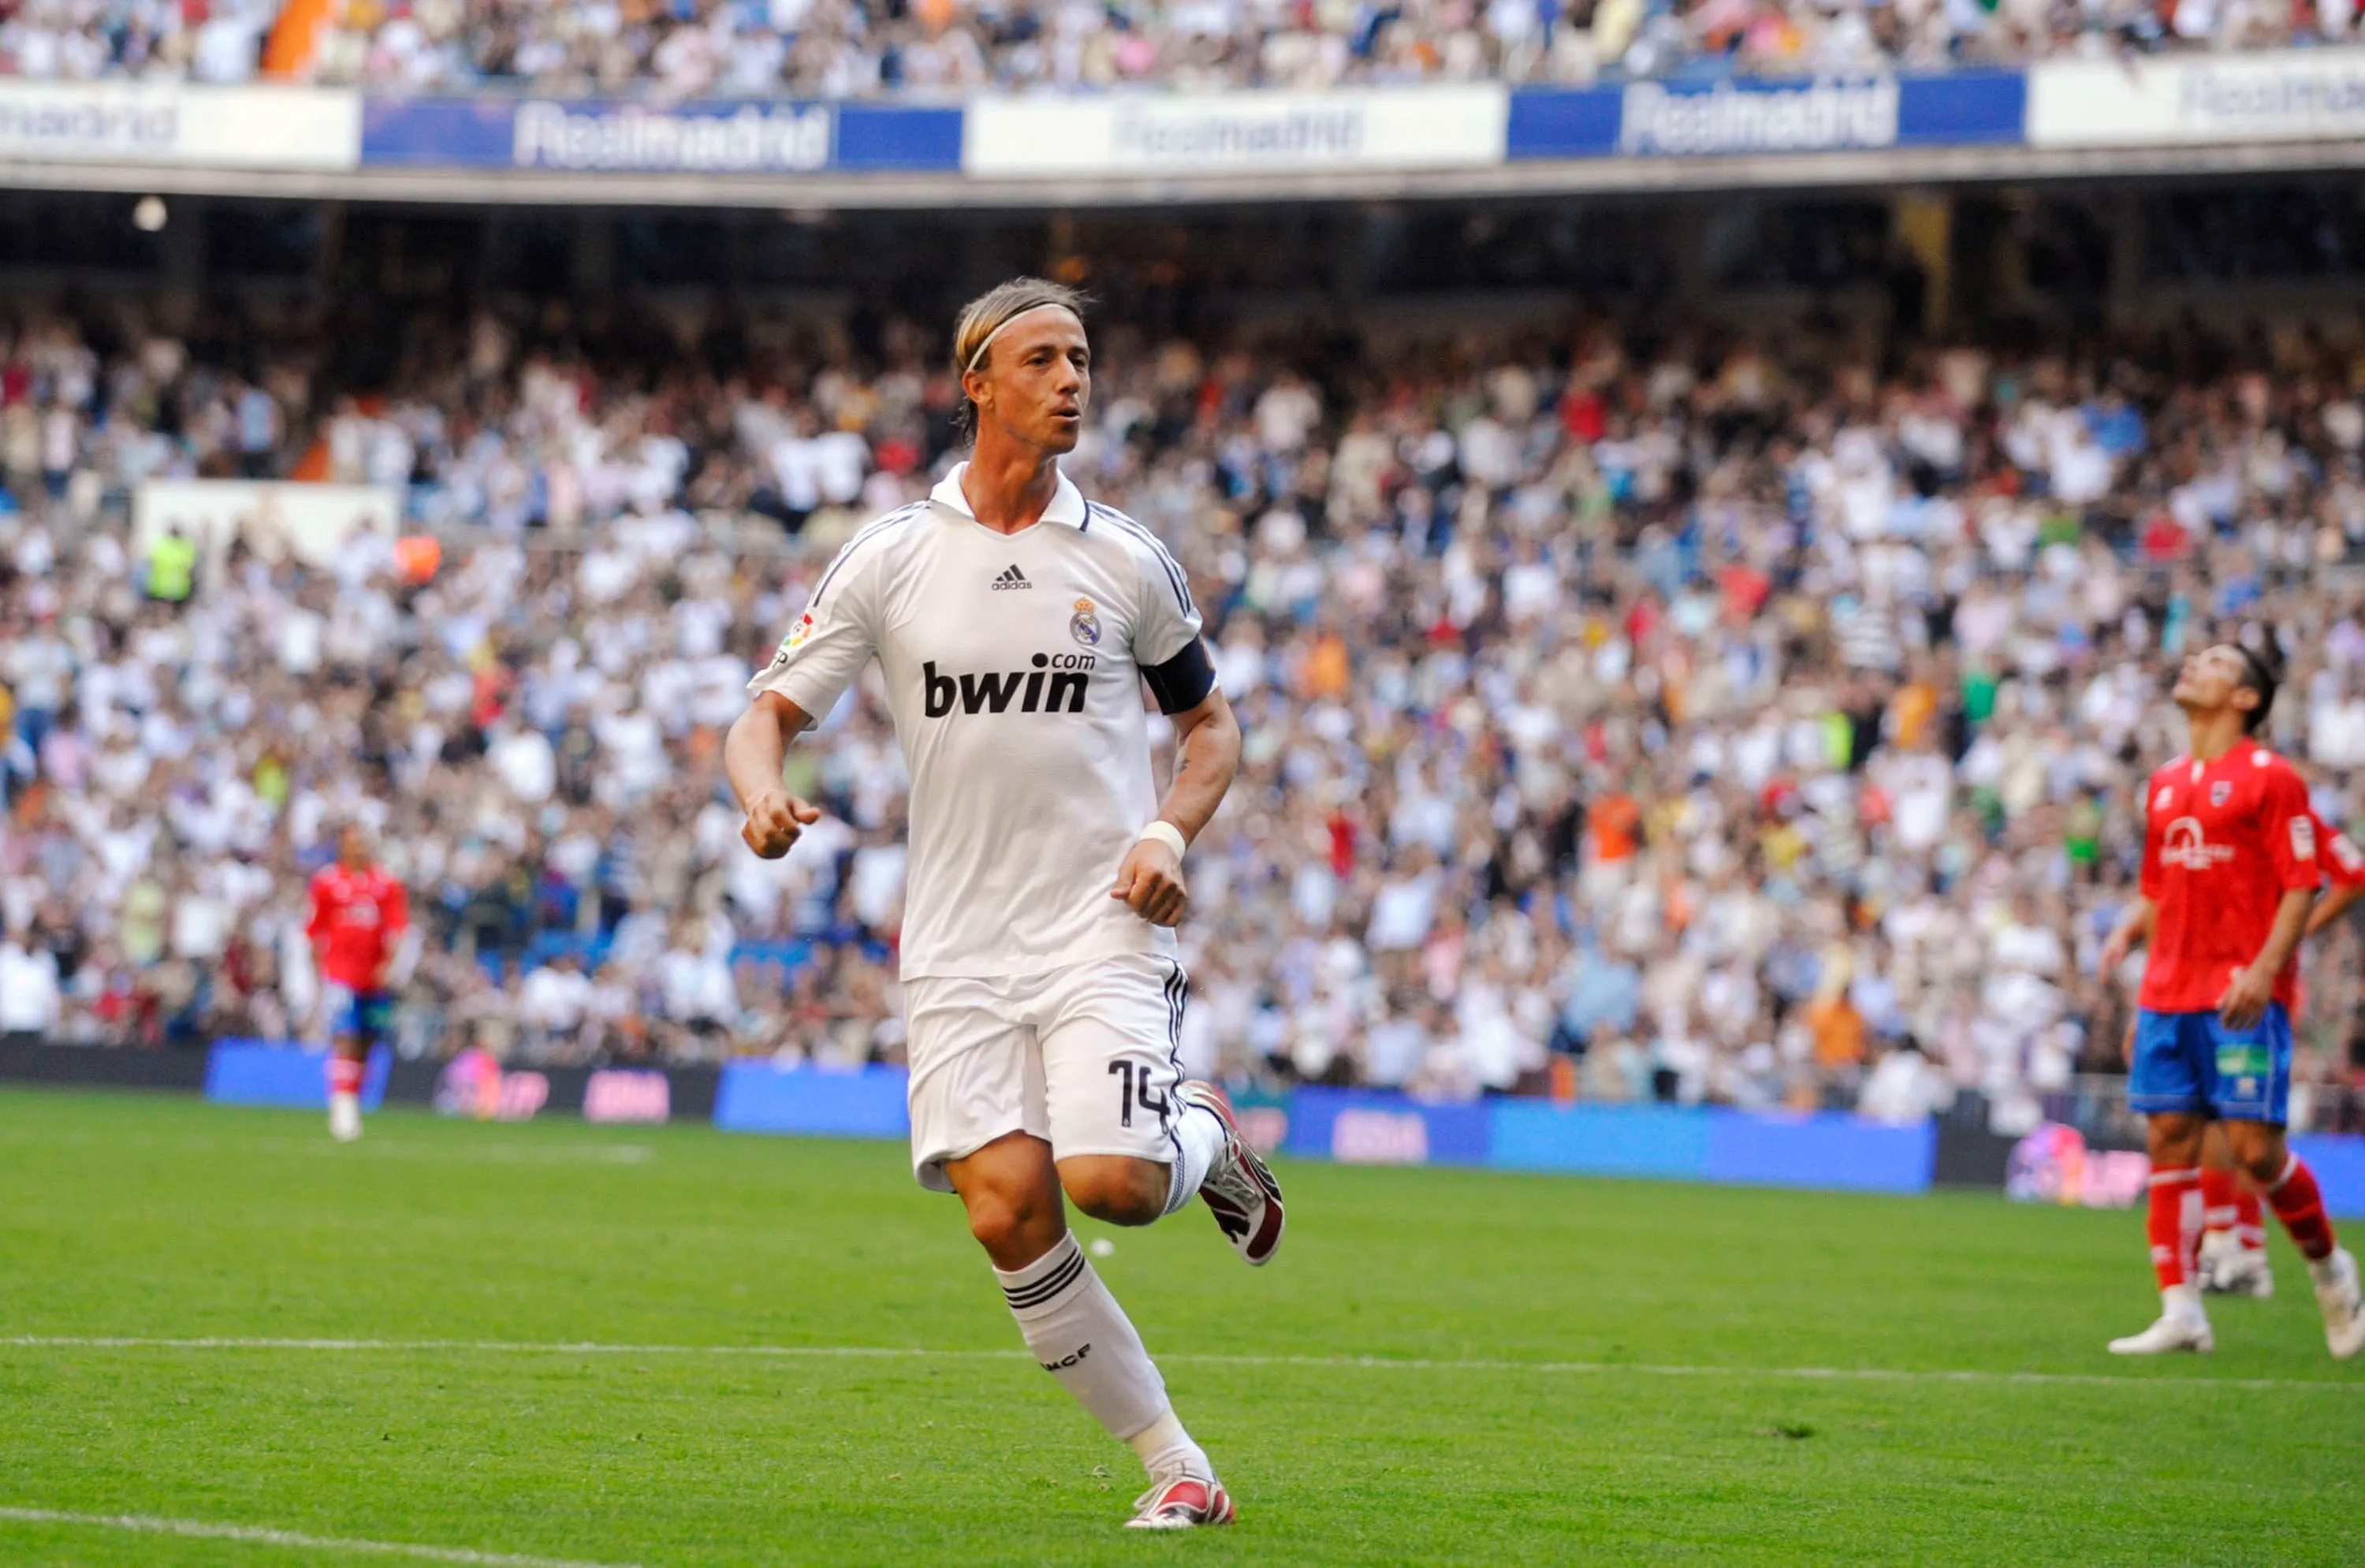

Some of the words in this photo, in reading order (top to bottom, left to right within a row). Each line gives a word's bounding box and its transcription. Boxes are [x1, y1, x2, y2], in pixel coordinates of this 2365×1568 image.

[992, 581, 1032, 590] adidas
[923, 653, 1089, 718] bwin
[1108, 1060, 1171, 1135] 14
